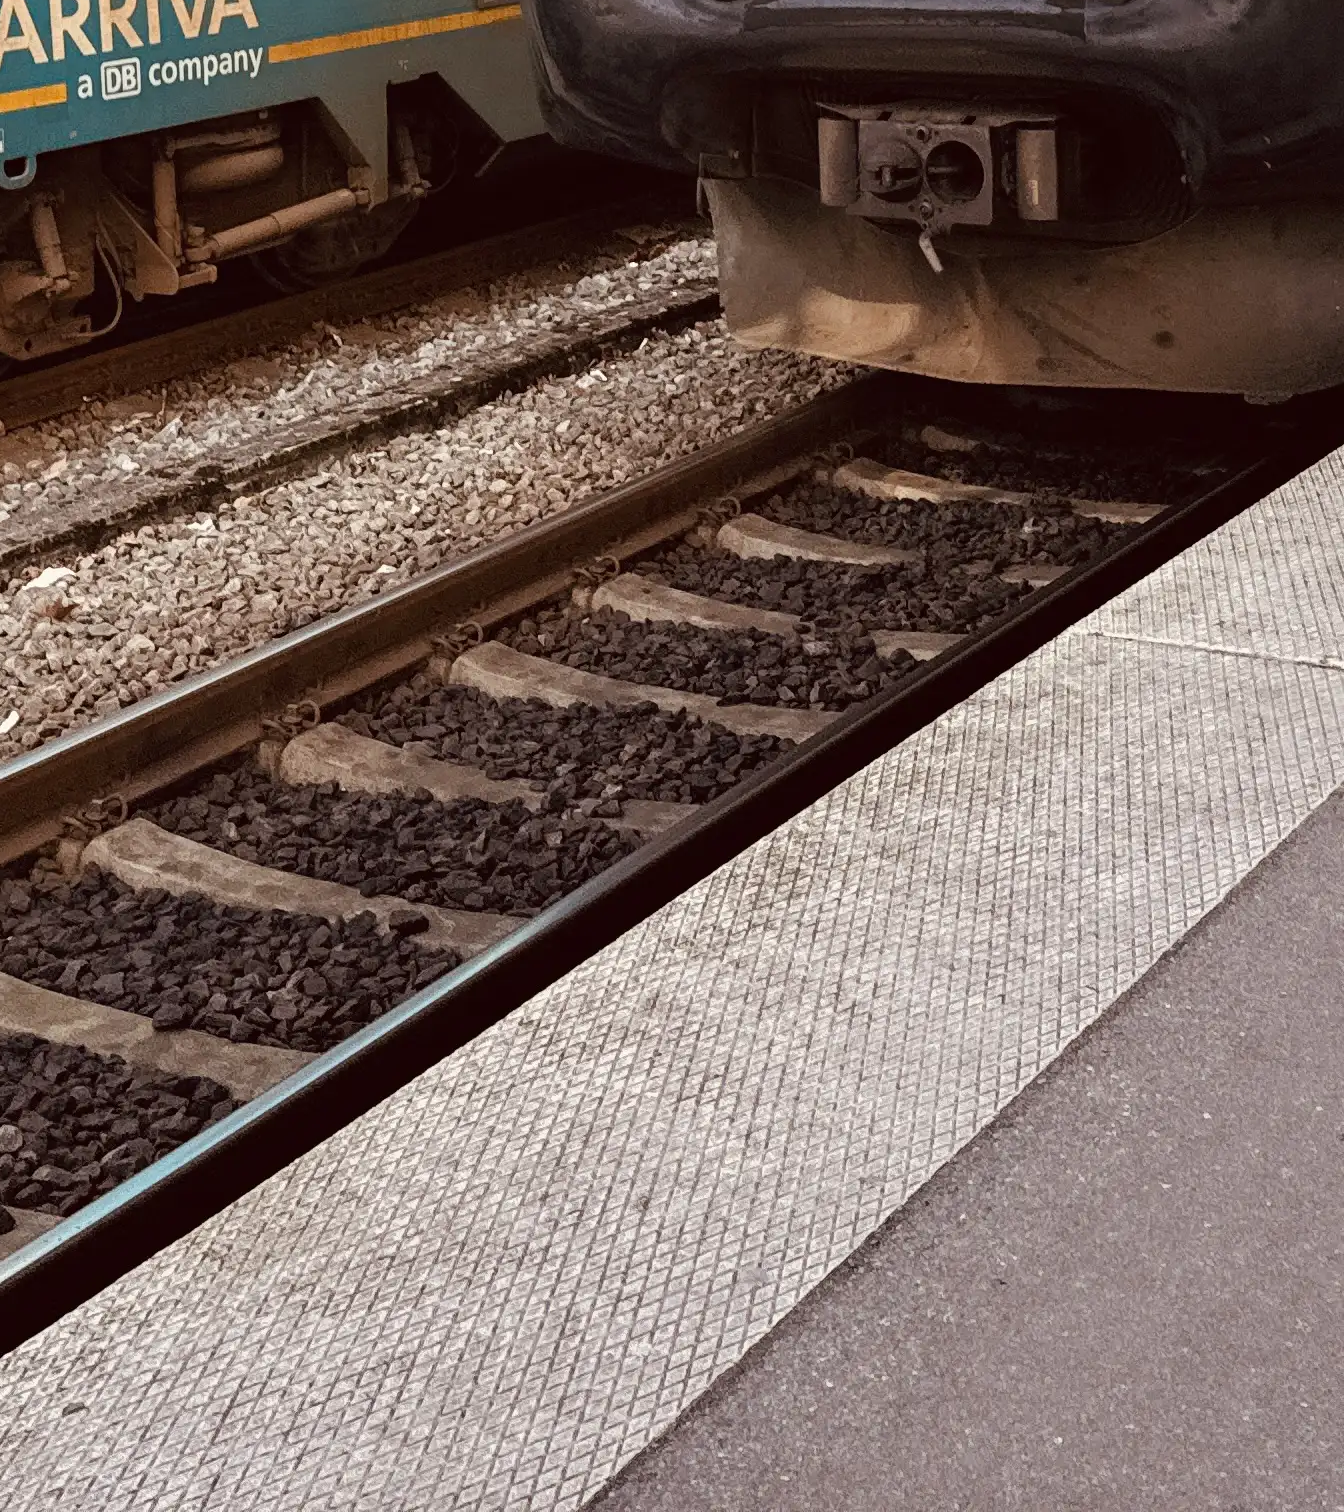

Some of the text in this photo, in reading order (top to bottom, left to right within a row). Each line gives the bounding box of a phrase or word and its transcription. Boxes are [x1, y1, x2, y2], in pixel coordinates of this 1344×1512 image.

[76, 46, 264, 100] a DB company
